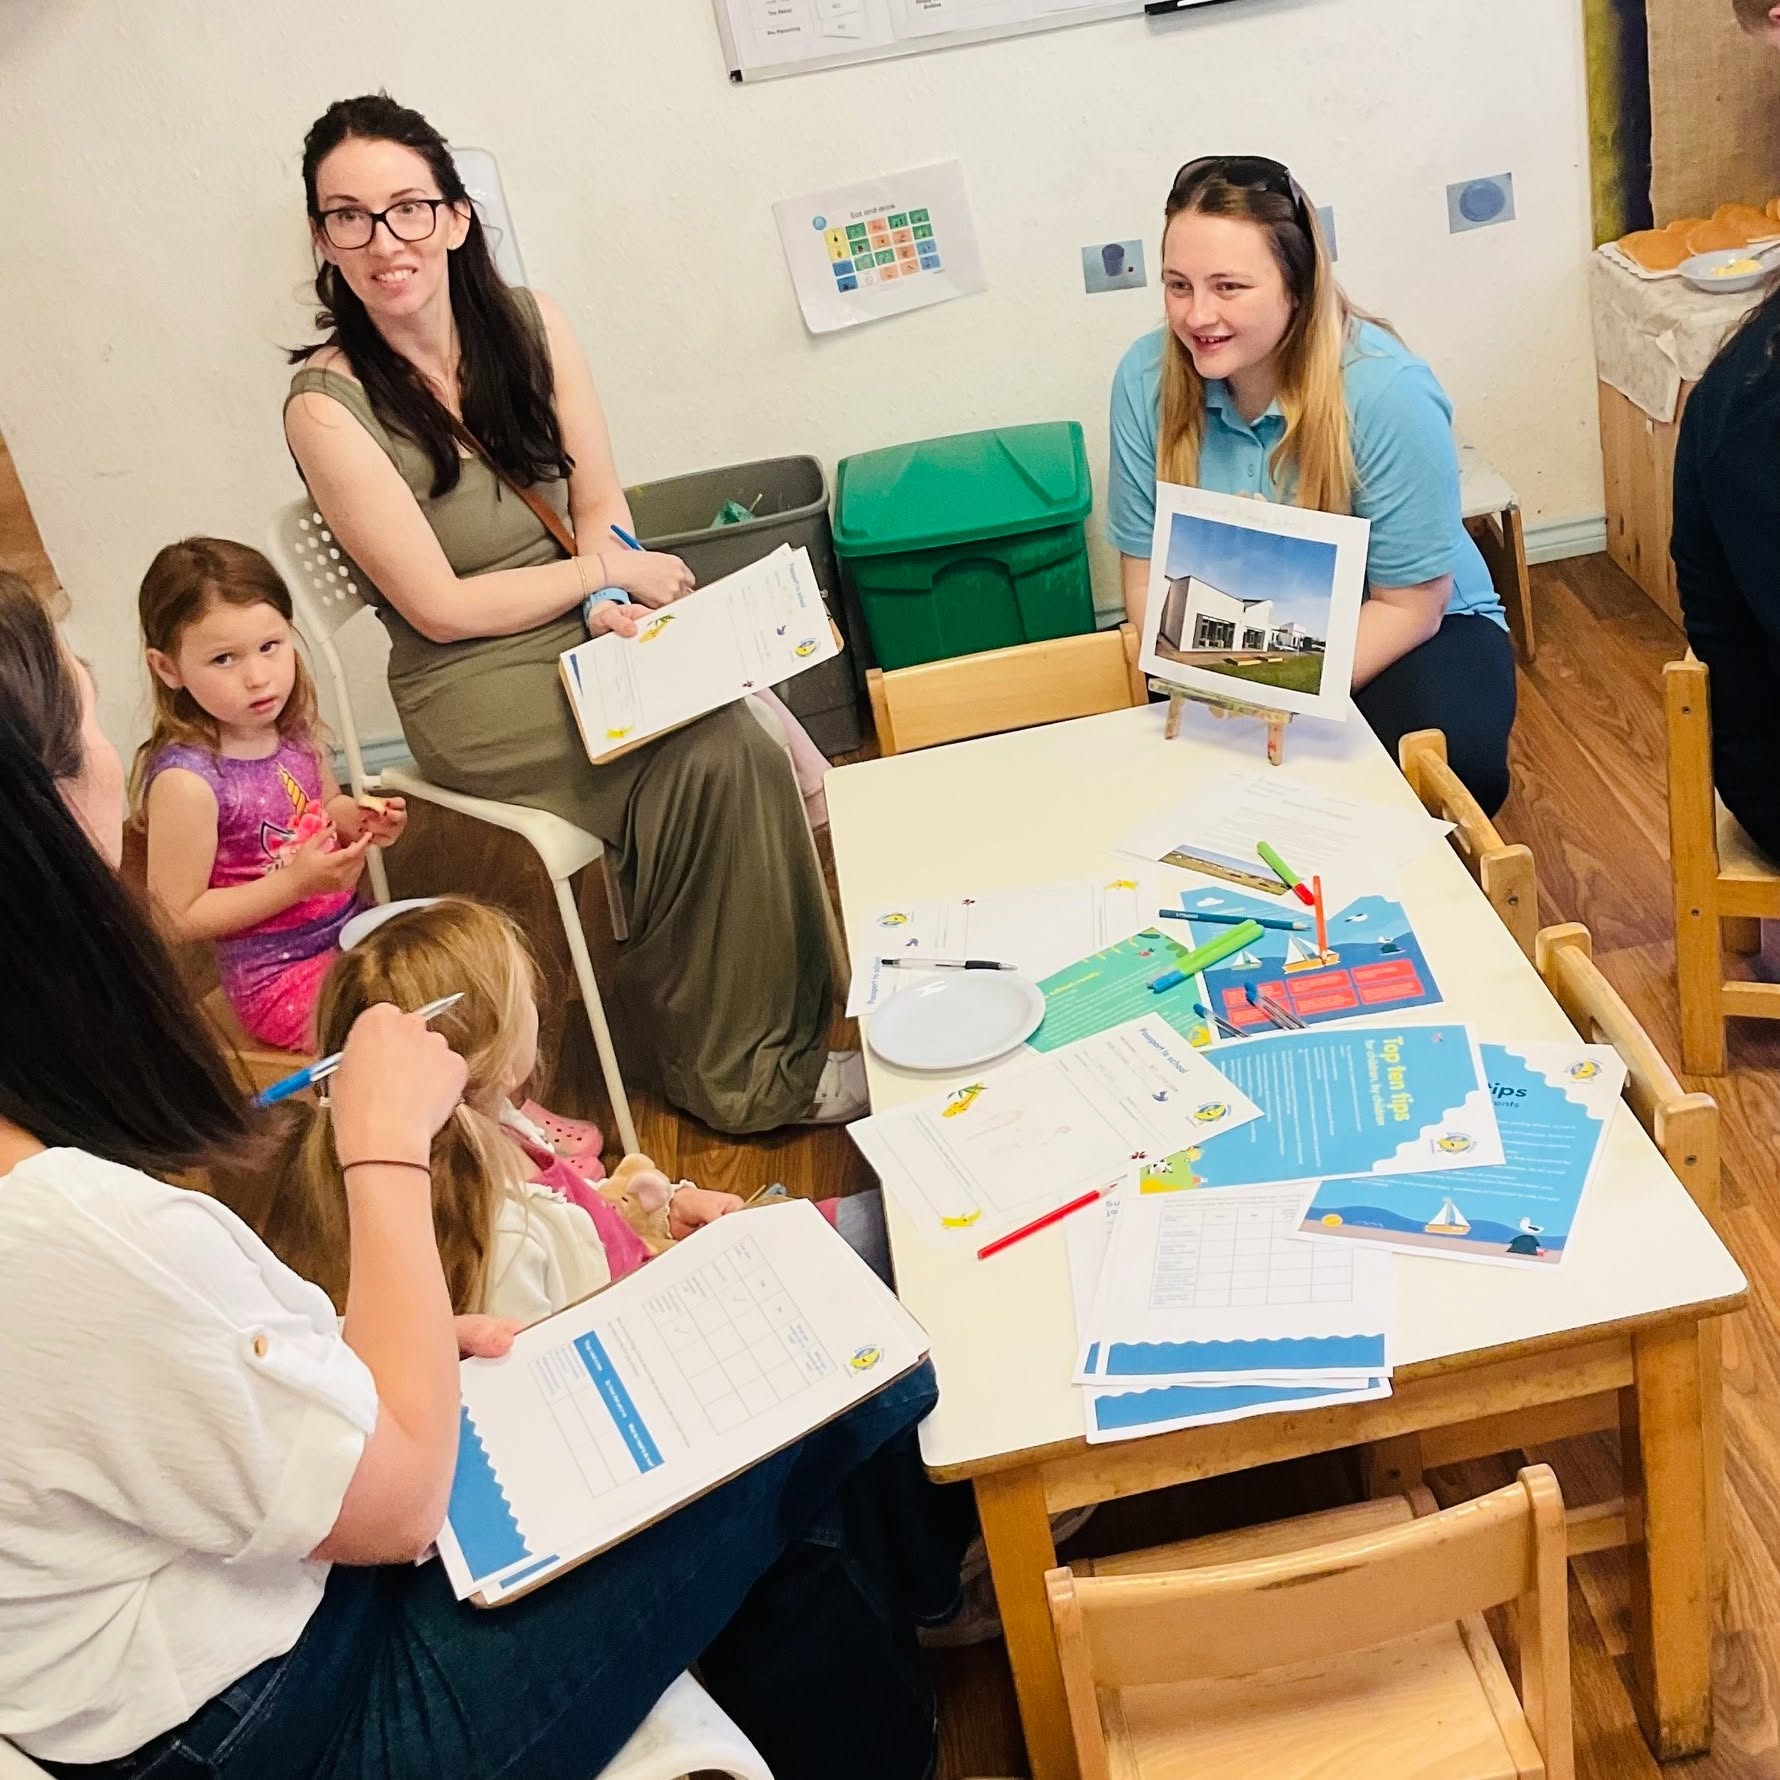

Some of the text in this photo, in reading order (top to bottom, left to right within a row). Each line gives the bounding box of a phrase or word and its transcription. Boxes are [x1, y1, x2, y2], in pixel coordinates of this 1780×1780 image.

[1138, 1027, 1165, 1050] Passport
[1167, 1056, 1190, 1074] school
[1377, 1035, 1415, 1122] Top ten tips
